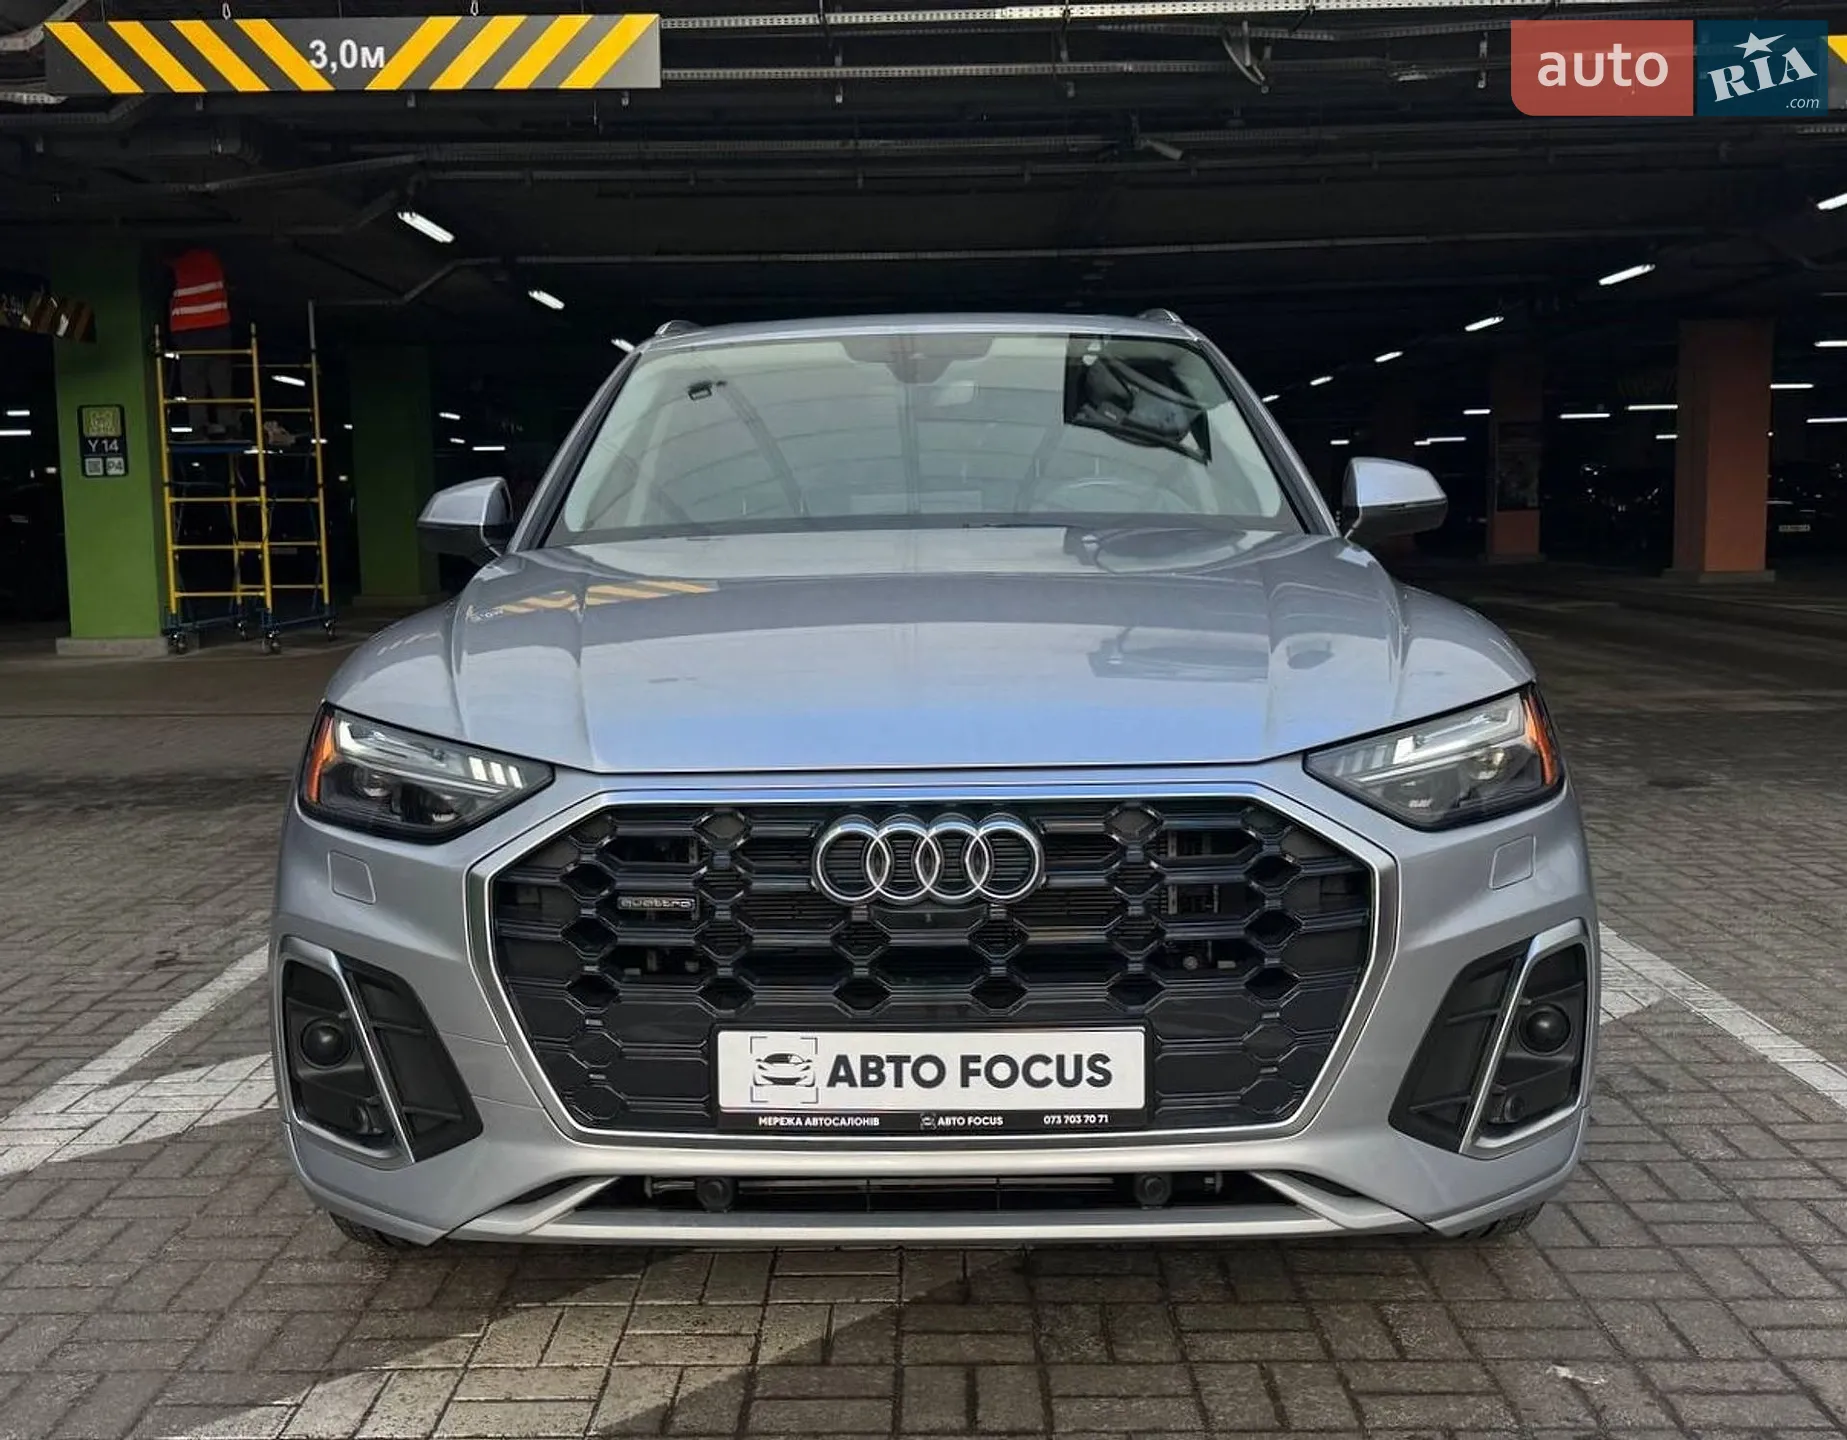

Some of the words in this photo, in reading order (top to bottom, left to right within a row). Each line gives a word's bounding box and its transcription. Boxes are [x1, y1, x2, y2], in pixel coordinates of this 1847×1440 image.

[309, 39, 384, 74] 3,0м
[102, 439, 119, 452] 14
[107, 461, 123, 472] P4
[620, 899, 692, 909] quattro
[960, 1053, 1112, 1088] FOCUS
[758, 1116, 802, 1126] МЕРЕЖА
[804, 1116, 880, 1126] АВТОСАЛОНІВ
[967, 1115, 1004, 1126] FOCUS
[1043, 1114, 1062, 1125] 073
[1064, 1114, 1082, 1124] 703
[1084, 1114, 1096, 1124] 70
[1098, 1114, 1109, 1123] 71
